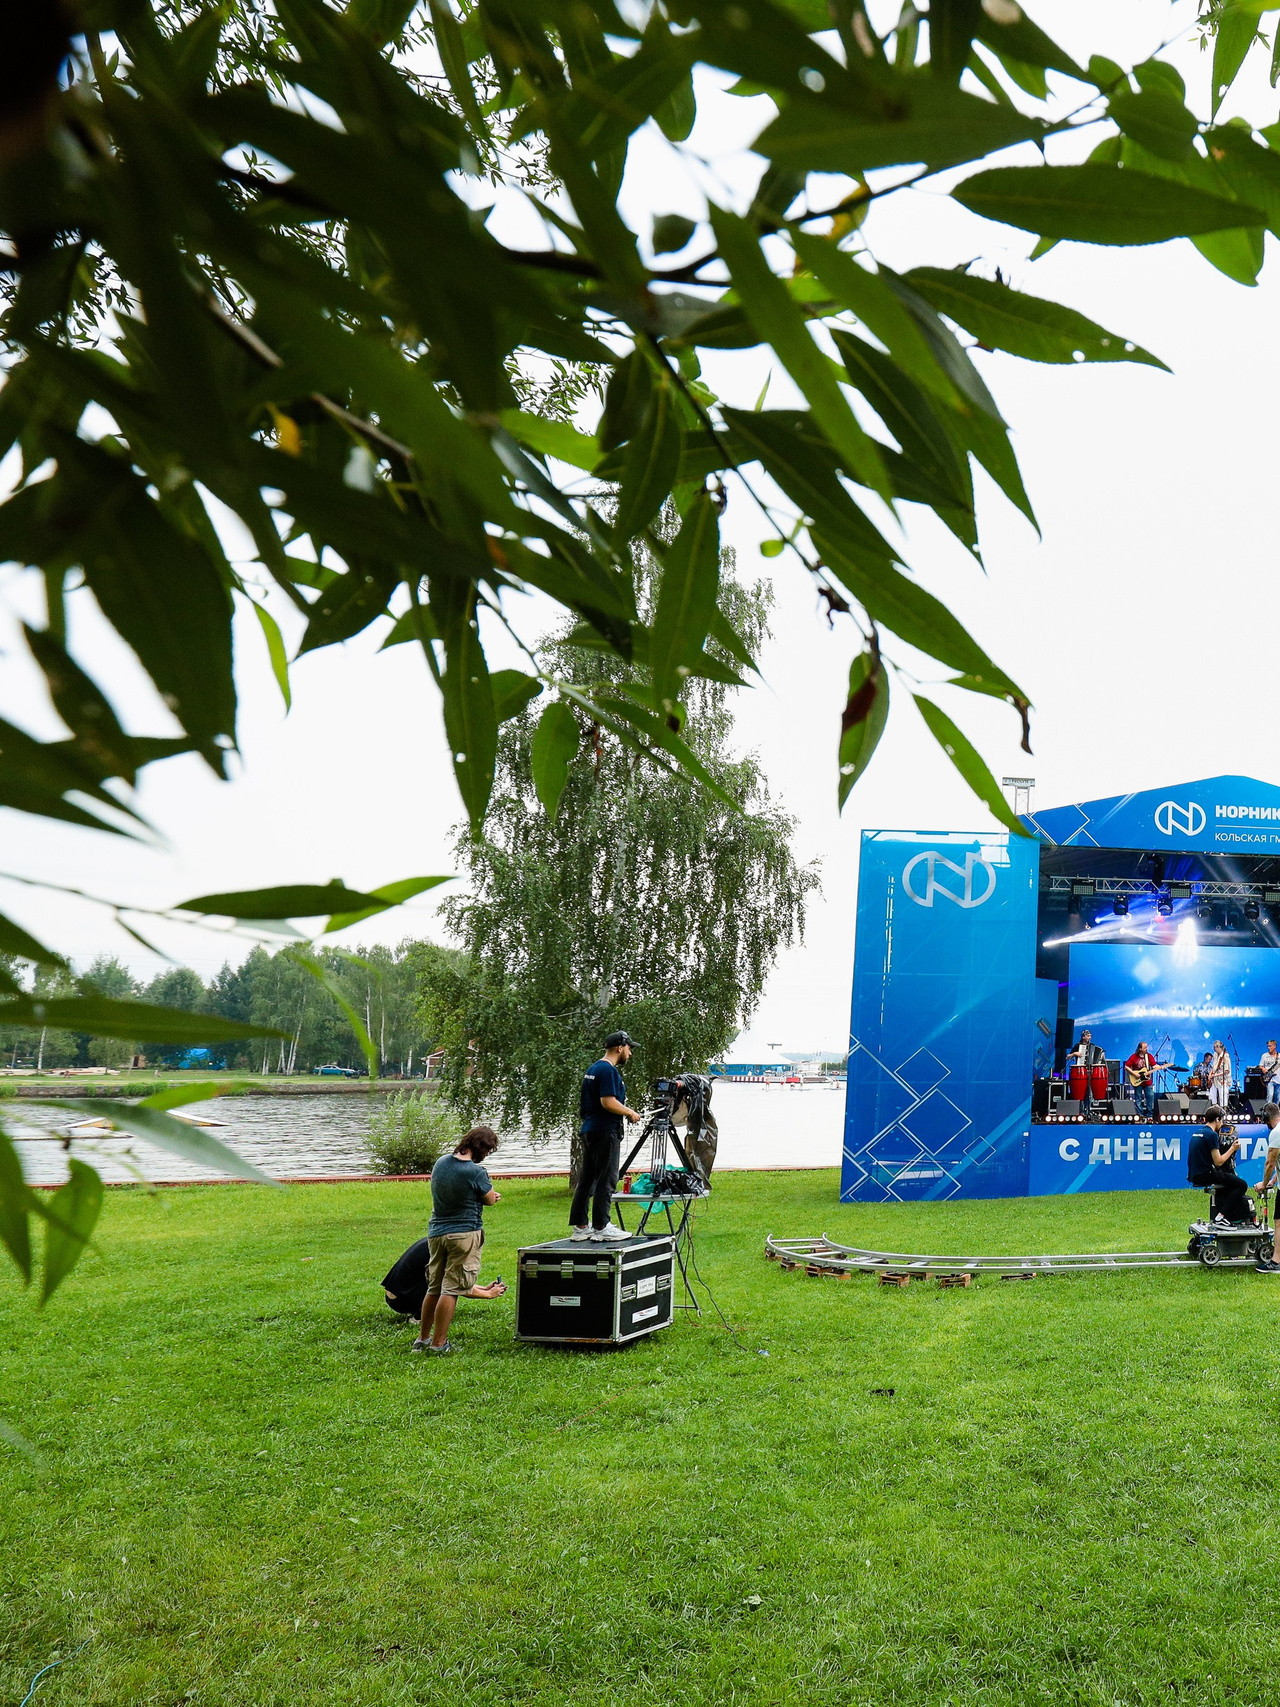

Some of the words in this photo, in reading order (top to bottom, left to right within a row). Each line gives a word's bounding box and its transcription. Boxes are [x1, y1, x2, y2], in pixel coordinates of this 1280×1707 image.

[1214, 832, 1268, 843] КОЛЬСКАЯ
[1058, 1138, 1081, 1162] С
[1088, 1131, 1181, 1165] ДНЁМ
